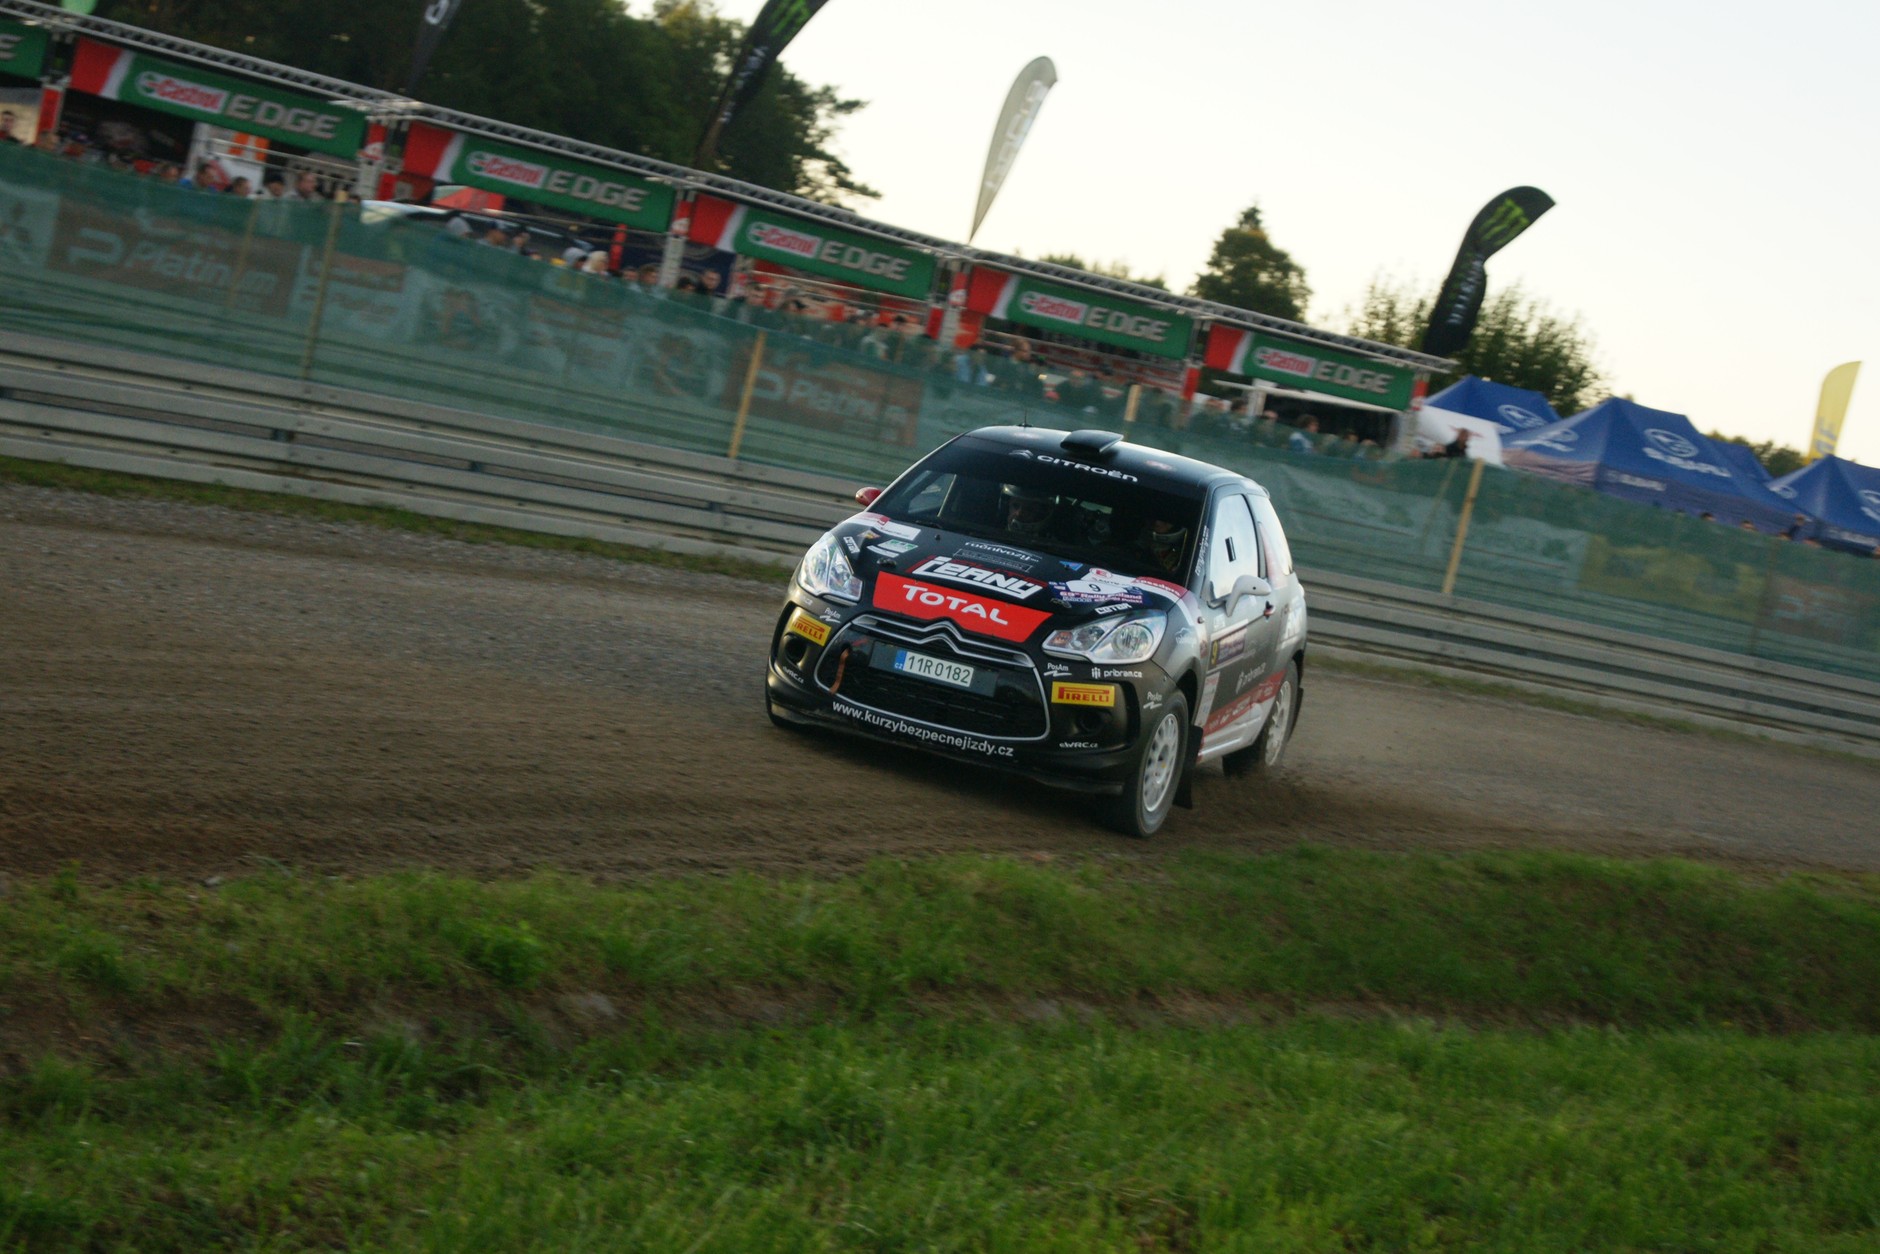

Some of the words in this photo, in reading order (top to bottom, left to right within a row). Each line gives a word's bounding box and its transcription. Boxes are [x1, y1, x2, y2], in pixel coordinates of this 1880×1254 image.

[147, 78, 227, 110] Castrol
[223, 94, 343, 139] EDGE
[480, 156, 546, 185] Castrol
[546, 169, 649, 212] EDGE
[756, 227, 819, 255] Castrol
[819, 240, 913, 282] EDGE
[1032, 296, 1084, 321] Castrol
[1084, 306, 1172, 342] EDGE
[1313, 360, 1395, 394] EDGE
[902, 584, 1009, 626] TOTAL
[1088, 583, 1101, 592] 9
[894, 662, 903, 670] CZ
[1057, 686, 1110, 703] PIRELLI
[832, 701, 1014, 757] www.kurzybezpecnejizdy.cz
